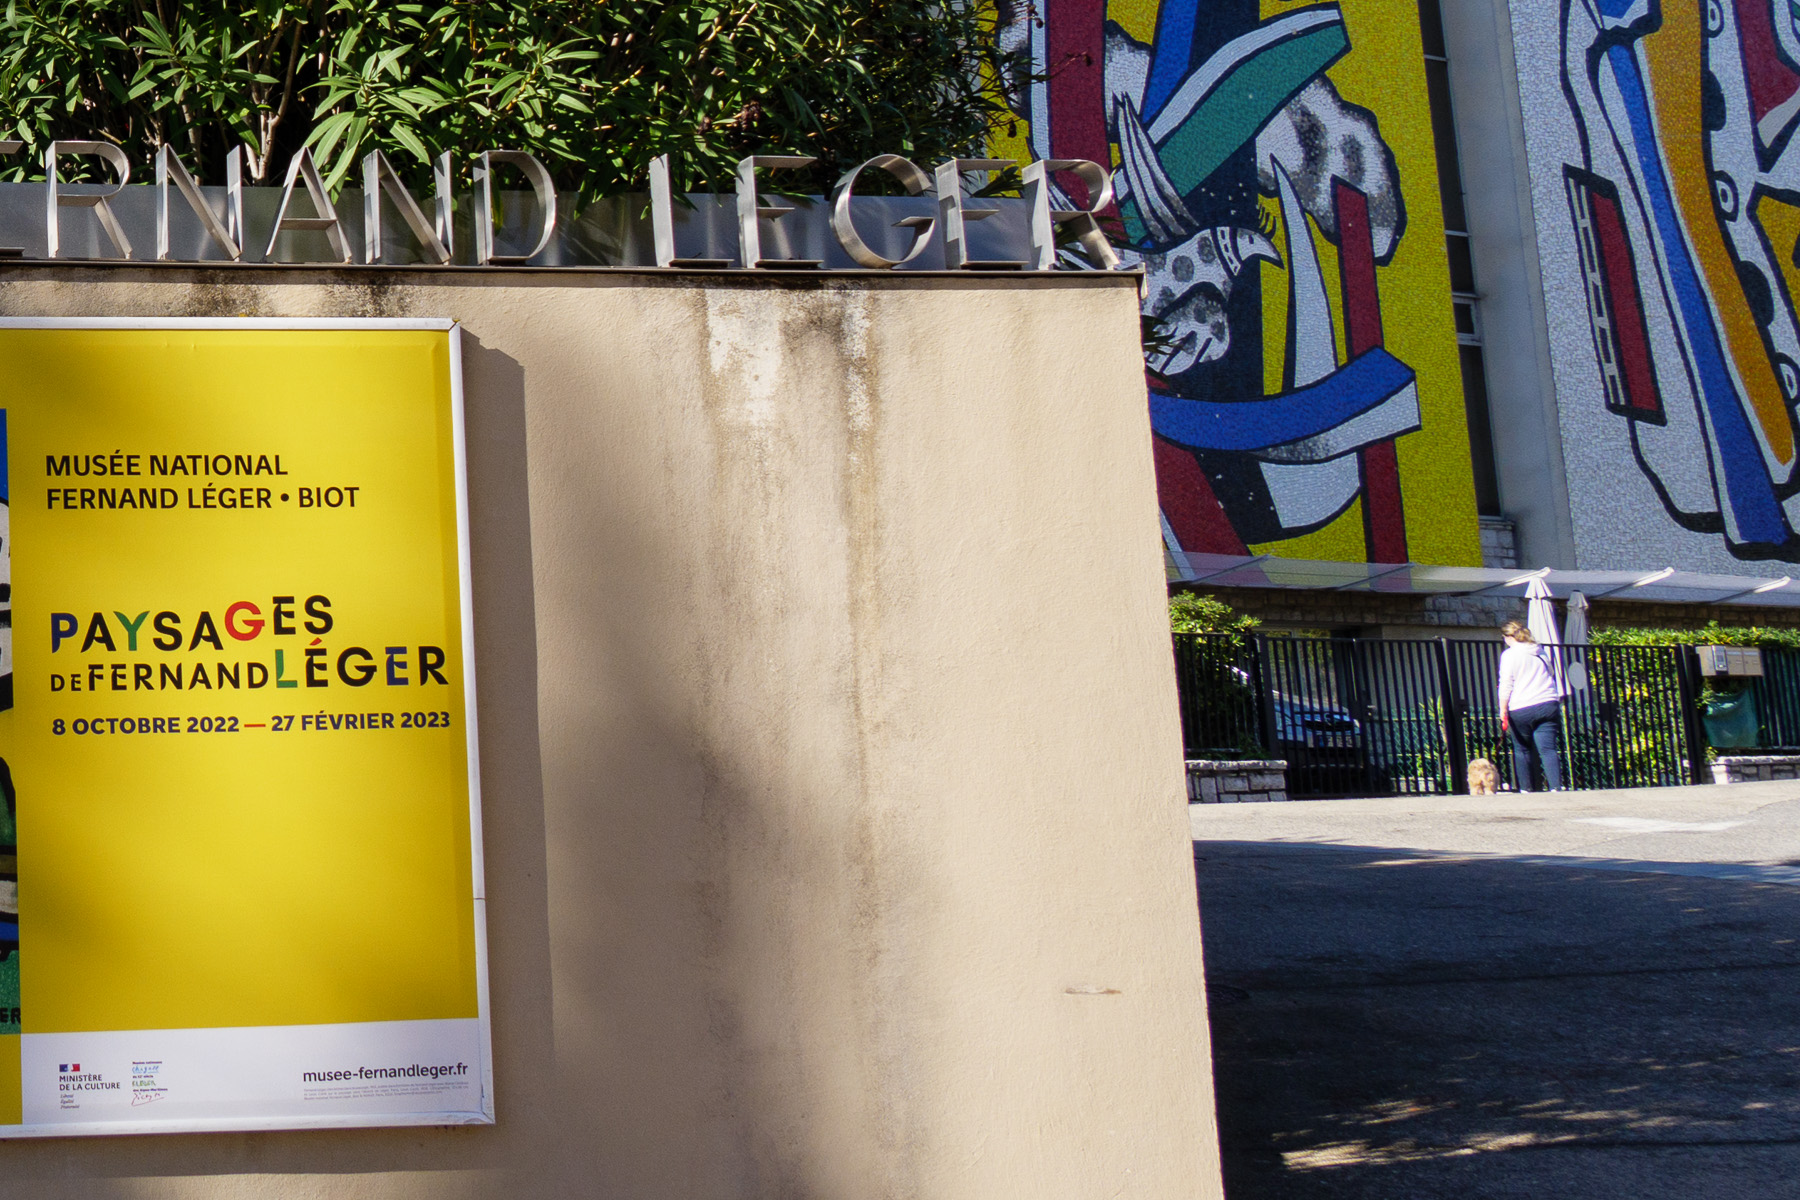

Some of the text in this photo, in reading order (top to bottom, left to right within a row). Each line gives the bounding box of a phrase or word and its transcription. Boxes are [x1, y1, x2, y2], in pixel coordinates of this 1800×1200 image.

[648, 152, 1121, 272] LEGER
[45, 449, 288, 476] MUSÉE NATIONAL
[46, 482, 360, 510] FERNAND LÉGER BIOT
[50, 594, 334, 653] PAYSAGES
[50, 637, 449, 692] DE FERNAND LÉGER
[52, 709, 451, 736] 8 OCTOBRE 2022 27 FÉVRIER 2023
[59, 1073, 103, 1083] MINISTÈRE
[303, 1062, 469, 1082] musee-fernandleger.fr
[59, 1081, 121, 1091] DE LA CULTURE
